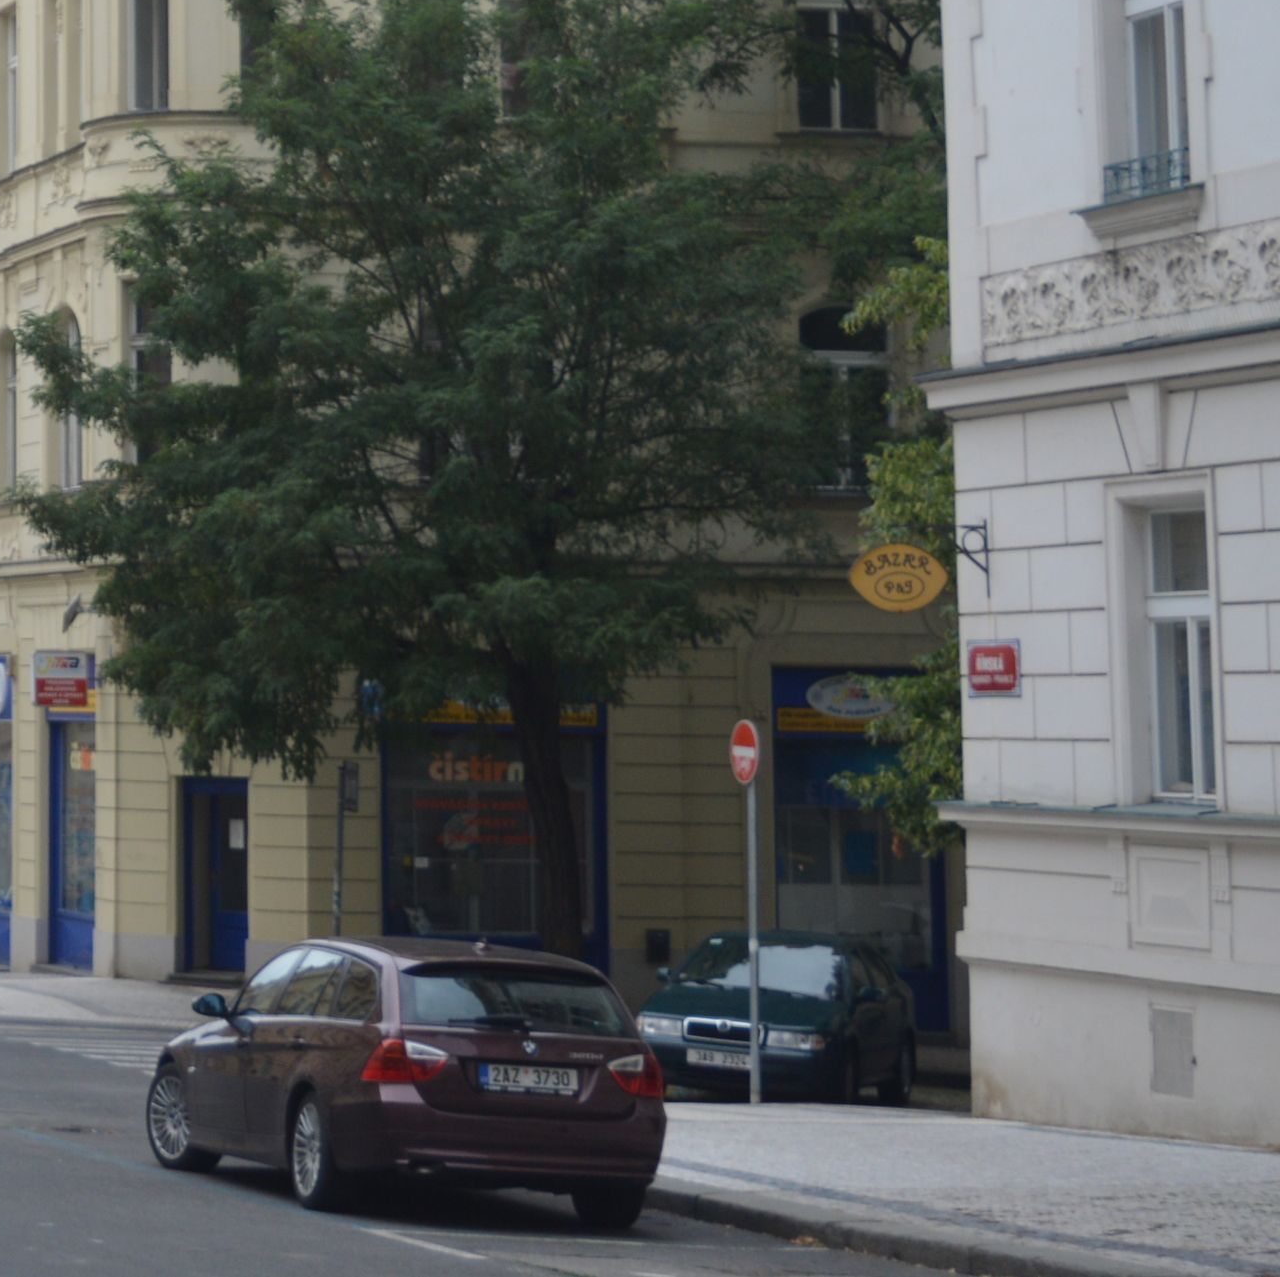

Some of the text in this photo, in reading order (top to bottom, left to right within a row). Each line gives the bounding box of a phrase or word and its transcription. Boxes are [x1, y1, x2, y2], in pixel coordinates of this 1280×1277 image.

[428, 750, 524, 782] čistírn
[492, 1066, 570, 1087] 2AZ 3730
